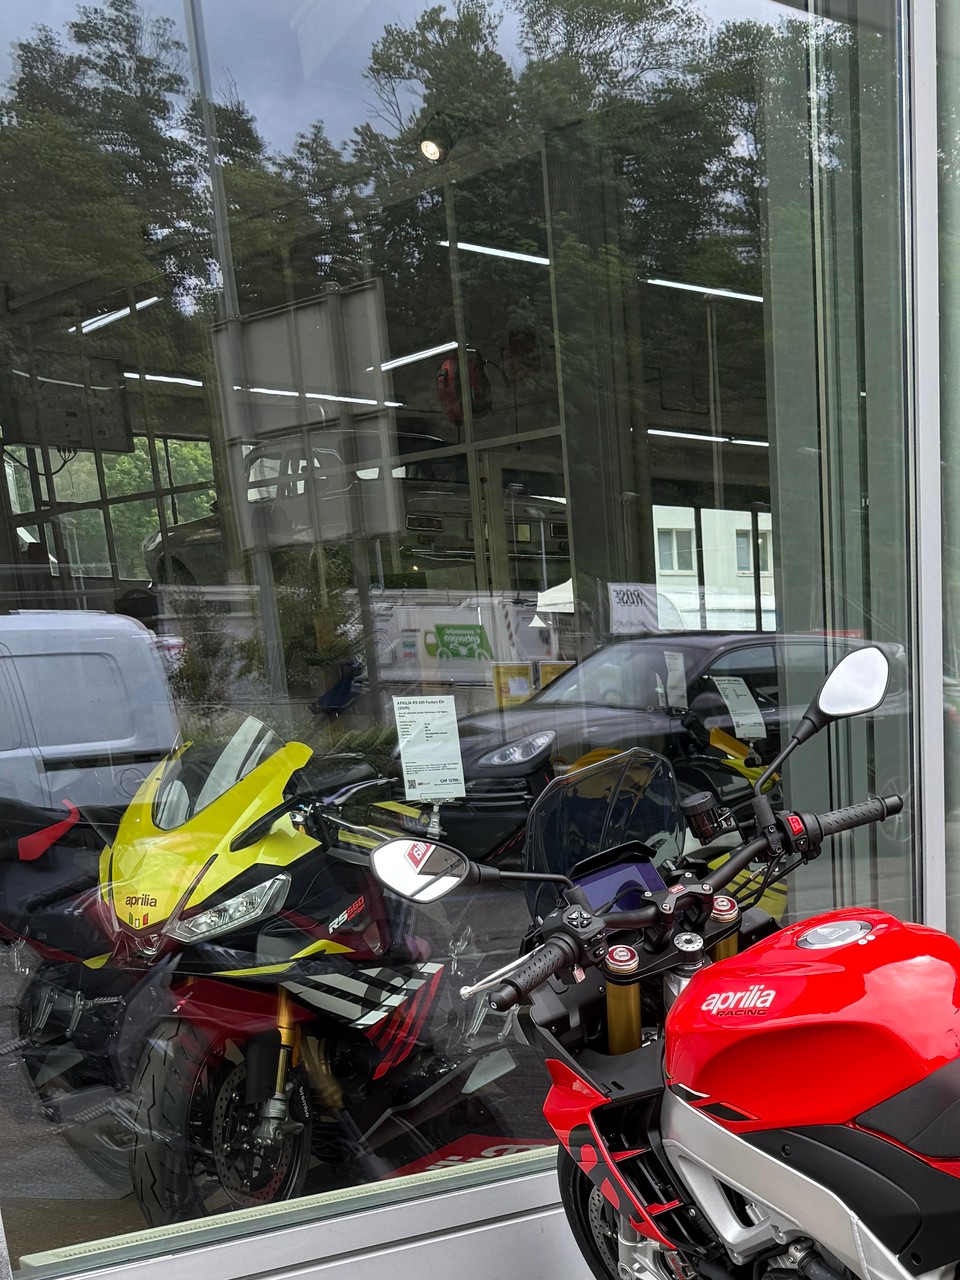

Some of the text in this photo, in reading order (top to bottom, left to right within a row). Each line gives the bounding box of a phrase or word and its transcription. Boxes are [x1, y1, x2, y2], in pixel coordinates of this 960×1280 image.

[125, 893, 158, 908] aprilia
[701, 984, 777, 1015] aprilia
[716, 1009, 768, 1017] RACING
